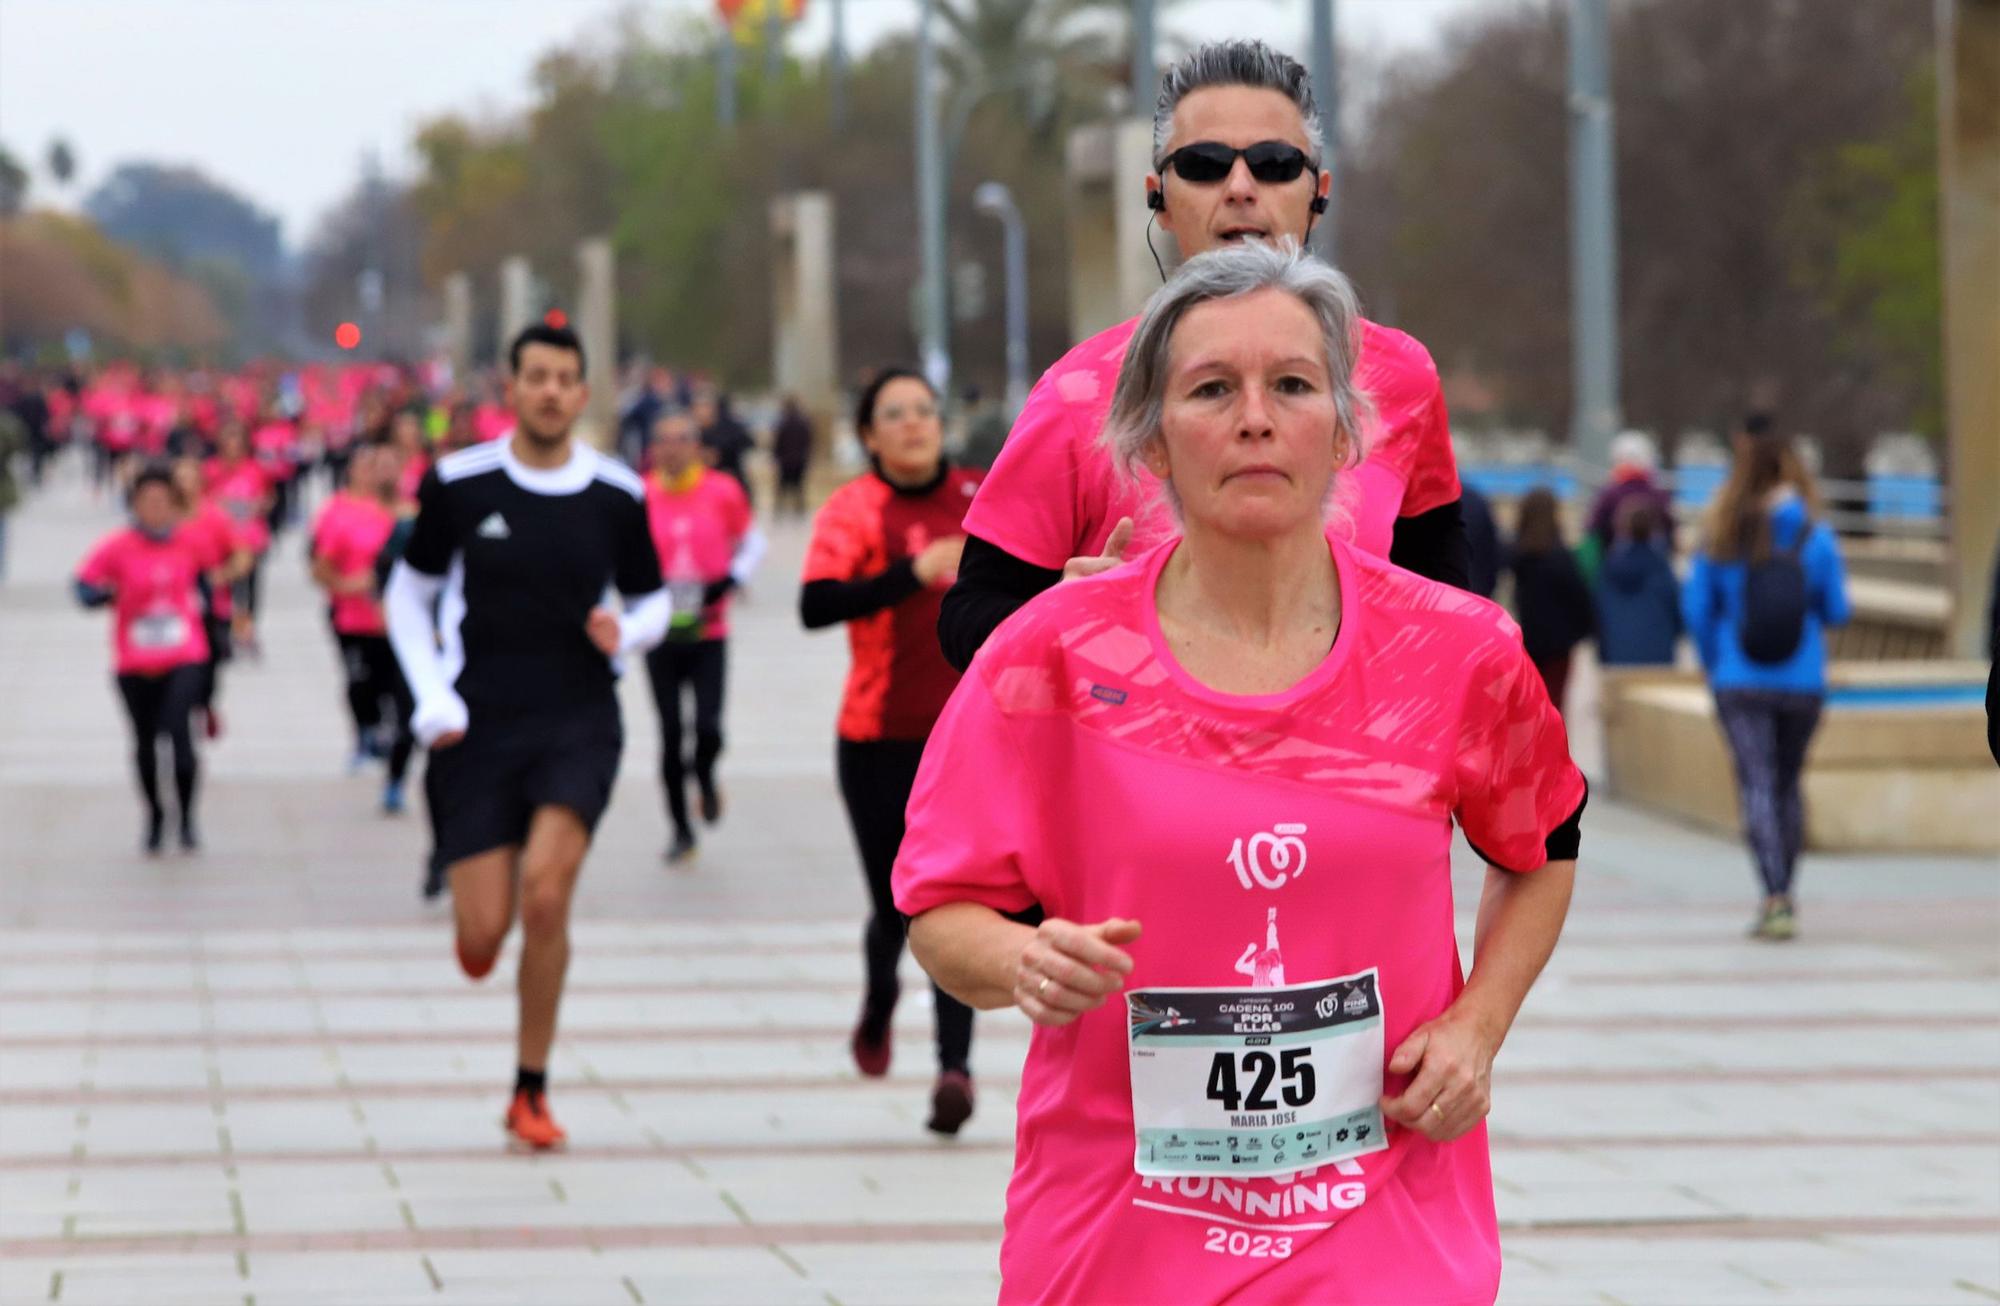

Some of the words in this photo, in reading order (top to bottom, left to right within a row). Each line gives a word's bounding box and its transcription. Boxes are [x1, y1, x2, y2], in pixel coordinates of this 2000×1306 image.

[1219, 1004, 1271, 1013] CADENA
[1273, 1002, 1295, 1012] 100
[1241, 1013, 1273, 1023] POR
[1233, 1022, 1282, 1033] ELLAS
[1206, 1046, 1316, 1111] 425
[1231, 1115, 1268, 1127] MARIA
[1141, 1176, 1366, 1218] RUNNING
[1204, 1227, 1293, 1259] 2023
